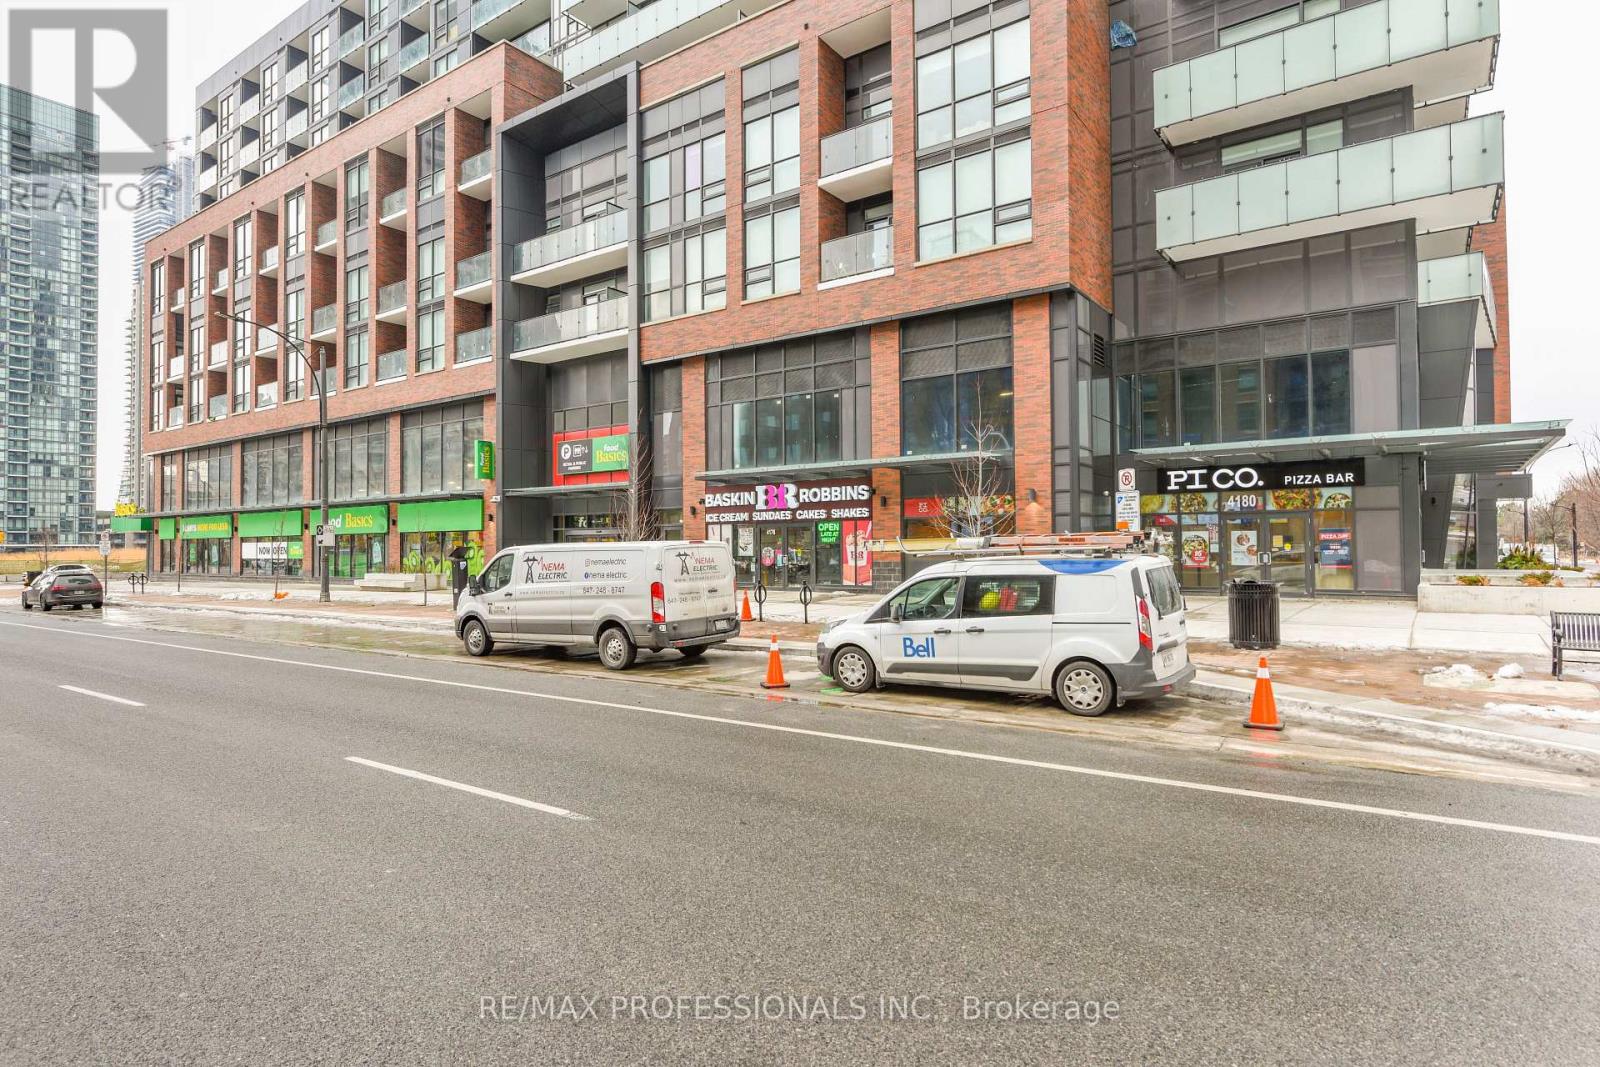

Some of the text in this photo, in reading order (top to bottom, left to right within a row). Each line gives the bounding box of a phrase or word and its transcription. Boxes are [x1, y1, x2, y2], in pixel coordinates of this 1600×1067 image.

[602, 443, 619, 452] food
[1284, 473, 1354, 485] PIZZA BAR
[705, 492, 756, 507] BASKIN
[799, 485, 870, 503] ROBBINS
[1227, 495, 1256, 508] 4180
[705, 507, 870, 522] ICE CREAM SUNDAES CAKES SHAKES
[818, 522, 840, 531] OPEN
[258, 547, 271, 555] NOW
[272, 546, 287, 555] OPEN
[590, 558, 627, 566] nemaelectric
[693, 556, 715, 564] NEMA
[541, 562, 566, 571] NEMA
[537, 572, 568, 580] ELECTRIC
[902, 637, 935, 658] Bell
